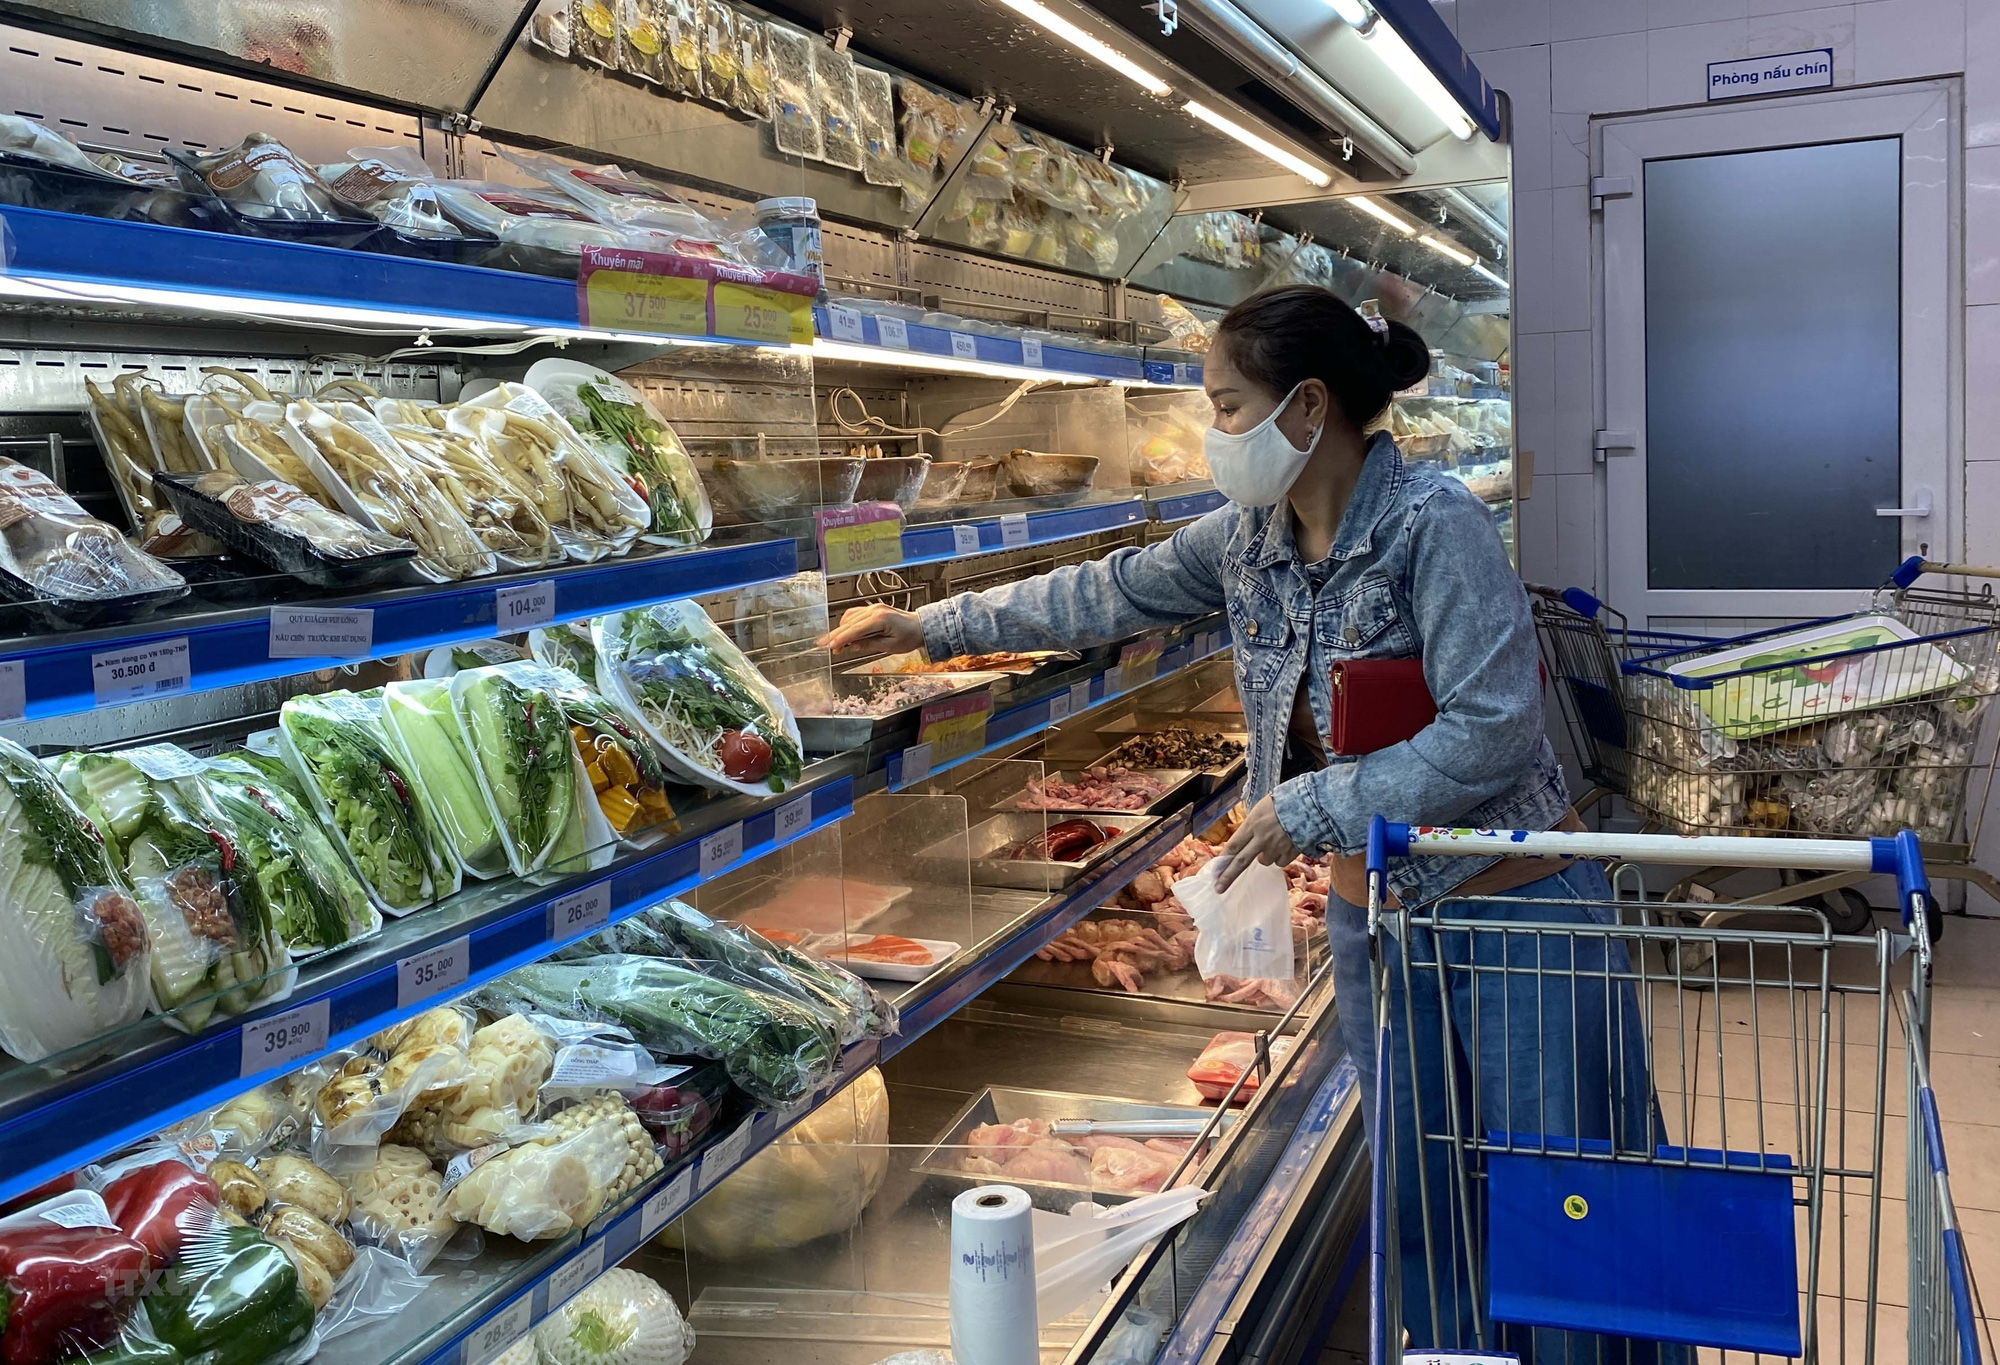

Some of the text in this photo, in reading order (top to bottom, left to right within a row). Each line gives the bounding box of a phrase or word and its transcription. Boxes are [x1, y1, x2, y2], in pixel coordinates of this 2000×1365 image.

[1712, 62, 1828, 86] Phòng nấu chín
[590, 252, 644, 270] Khuyến mãi
[105, 659, 121, 667] Nam
[121, 655, 138, 664] dong
[148, 650, 158, 658] VN
[111, 661, 155, 680] 30.500 đ
[567, 898, 599, 924] 26.000
[415, 956, 454, 986] 35.000
[264, 1021, 311, 1053] 39.900
